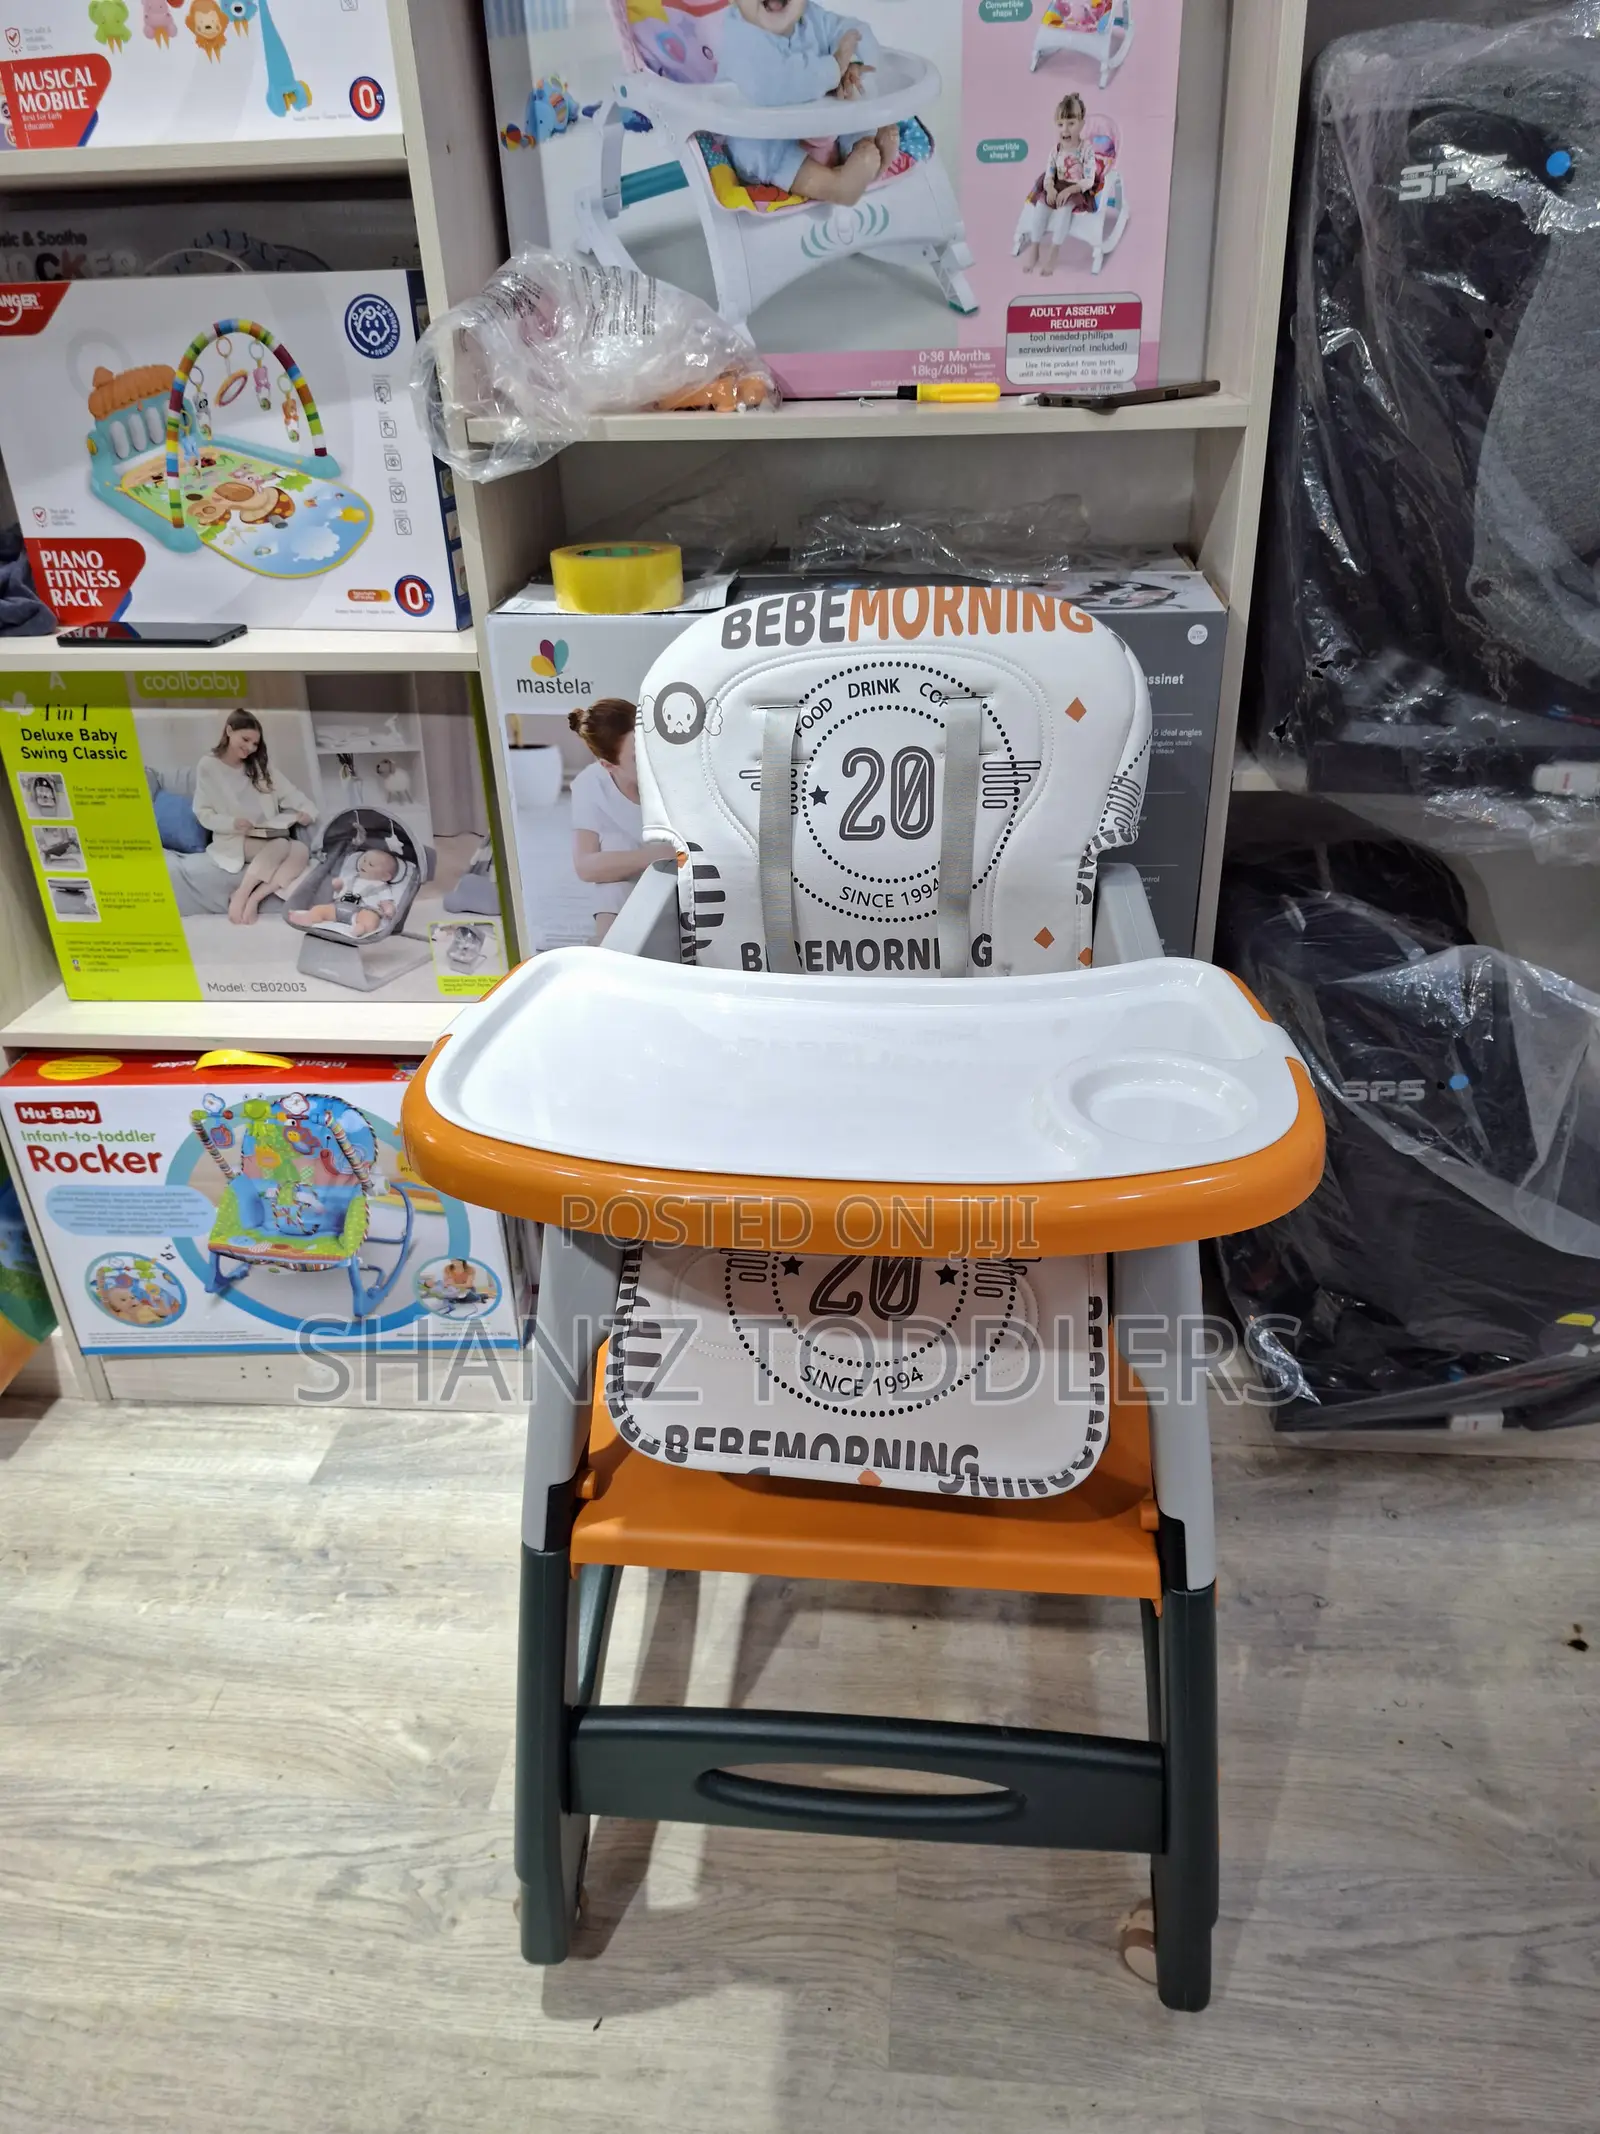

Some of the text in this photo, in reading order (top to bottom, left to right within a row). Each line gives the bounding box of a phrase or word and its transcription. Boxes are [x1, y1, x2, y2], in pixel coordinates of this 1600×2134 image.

[13, 66, 97, 92] MUSICAL
[18, 89, 90, 113] MOBILE
[1030, 305, 1116, 317] ADULT ASSEMBLY
[1050, 319, 1098, 329] REQUIRED
[1030, 333, 1046, 342] tool
[919, 350, 990, 362] 0-36 Months
[912, 364, 967, 379] 18kg/40lb
[40, 550, 103, 568] PIANO
[44, 570, 121, 588] FITNESS
[50, 589, 103, 607] RACK
[720, 585, 1094, 650] BEBEMORNING
[143, 672, 240, 695] coolbaby
[517, 678, 592, 694] mastela
[848, 677, 900, 698] DRINK
[1144, 674, 1184, 685] ssinet
[57, 703, 73, 721] in
[21, 728, 118, 744] Deluxe Baby
[1160, 728, 1178, 736] ideal
[1179, 728, 1202, 738] angles
[21, 747, 128, 763] Swing Classic
[839, 745, 935, 841] 20
[1140, 875, 1160, 883] ontrol
[839, 878, 939, 908] SINCE 1994
[207, 981, 246, 993] Model:
[1342, 1079, 1426, 1101] SPS
[20, 1107, 96, 1121] Hu-Baby
[21, 1130, 156, 1143] Infant-to-toddler
[26, 1144, 163, 1174] Rocker
[800, 1365, 924, 1396] SINCE 1994
